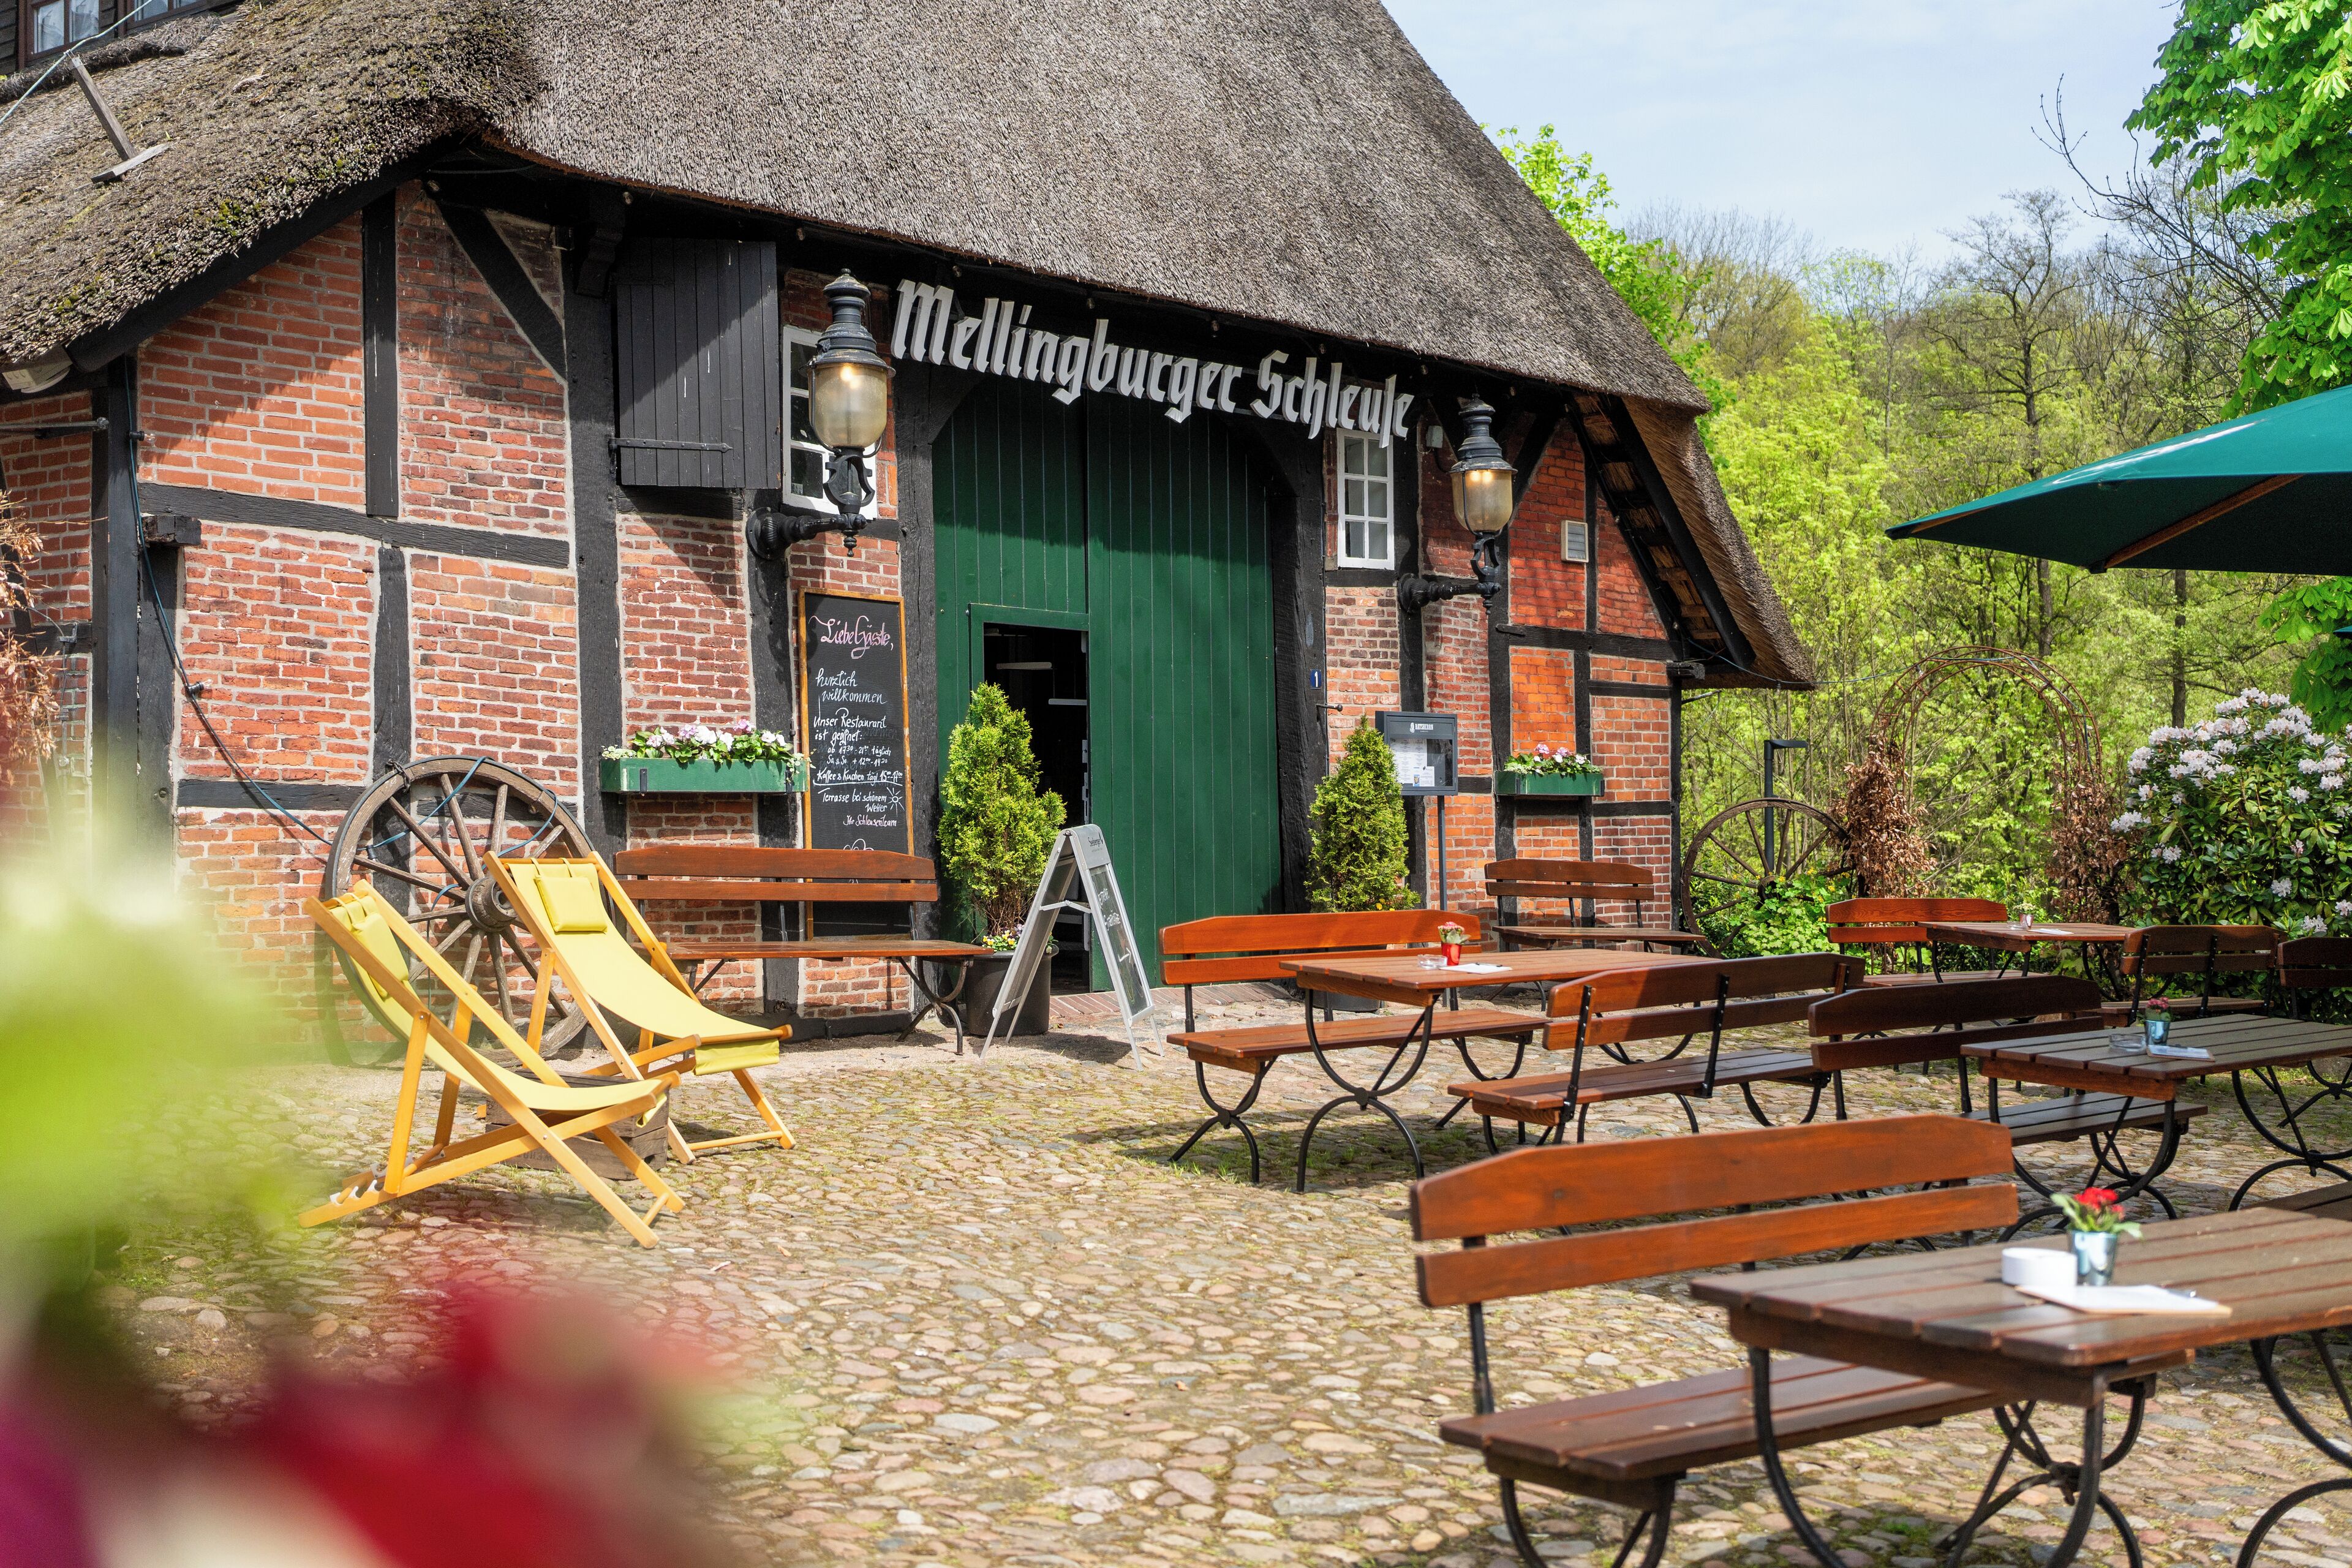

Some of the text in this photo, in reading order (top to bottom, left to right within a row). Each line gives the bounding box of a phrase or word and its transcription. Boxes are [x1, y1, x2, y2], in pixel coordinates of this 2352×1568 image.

[891, 279, 1242, 423] Mellingburger
[809, 616, 854, 644] Liebe
[815, 668, 858, 687] herzlich
[1314, 671, 1319, 687] 1
[822, 688, 888, 704] willkommen
[835, 707, 887, 728] Restaurant
[815, 729, 829, 741] ist
[871, 745, 891, 757] täglich
[827, 755, 834, 764] Sa
[841, 756, 847, 765] So
[816, 767, 836, 783] Kaffee
[843, 769, 864, 781] Kuchen
[818, 788, 887, 802] Terrasse bei schönem
[865, 803, 888, 813] Wetter
[843, 815, 854, 826] Ihr
